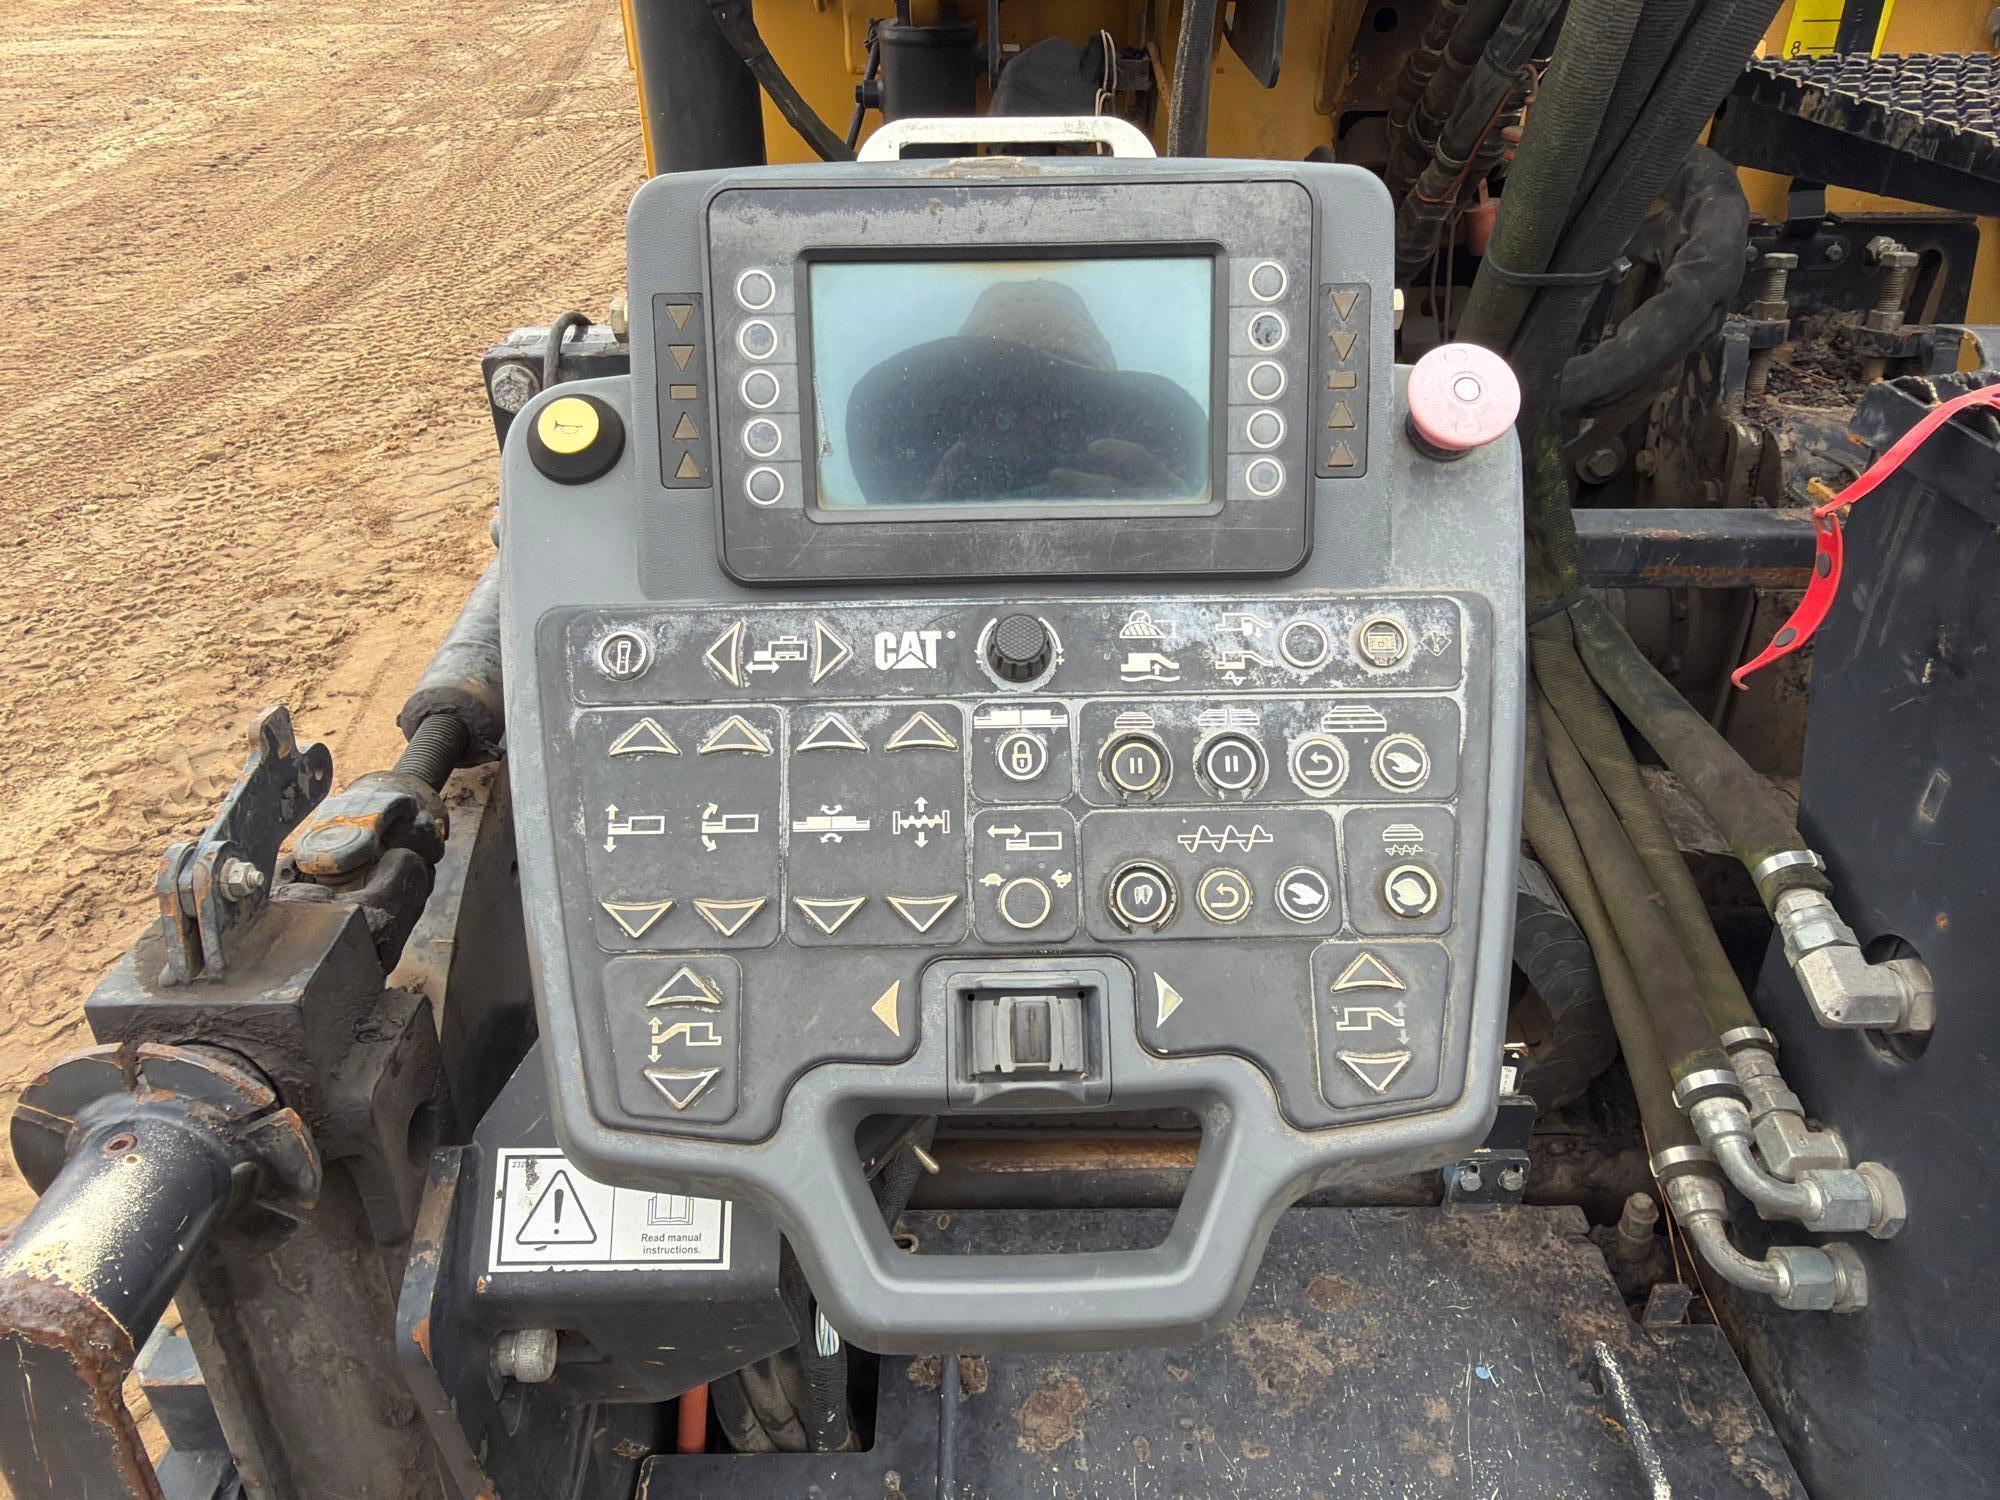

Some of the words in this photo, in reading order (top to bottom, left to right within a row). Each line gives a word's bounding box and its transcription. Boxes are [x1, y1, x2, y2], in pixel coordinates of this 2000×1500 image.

[1791, 41, 1801, 56] 8
[641, 1233, 665, 1242] Read
[667, 1232, 702, 1242] manual
[642, 1245, 702, 1254] instructions.
